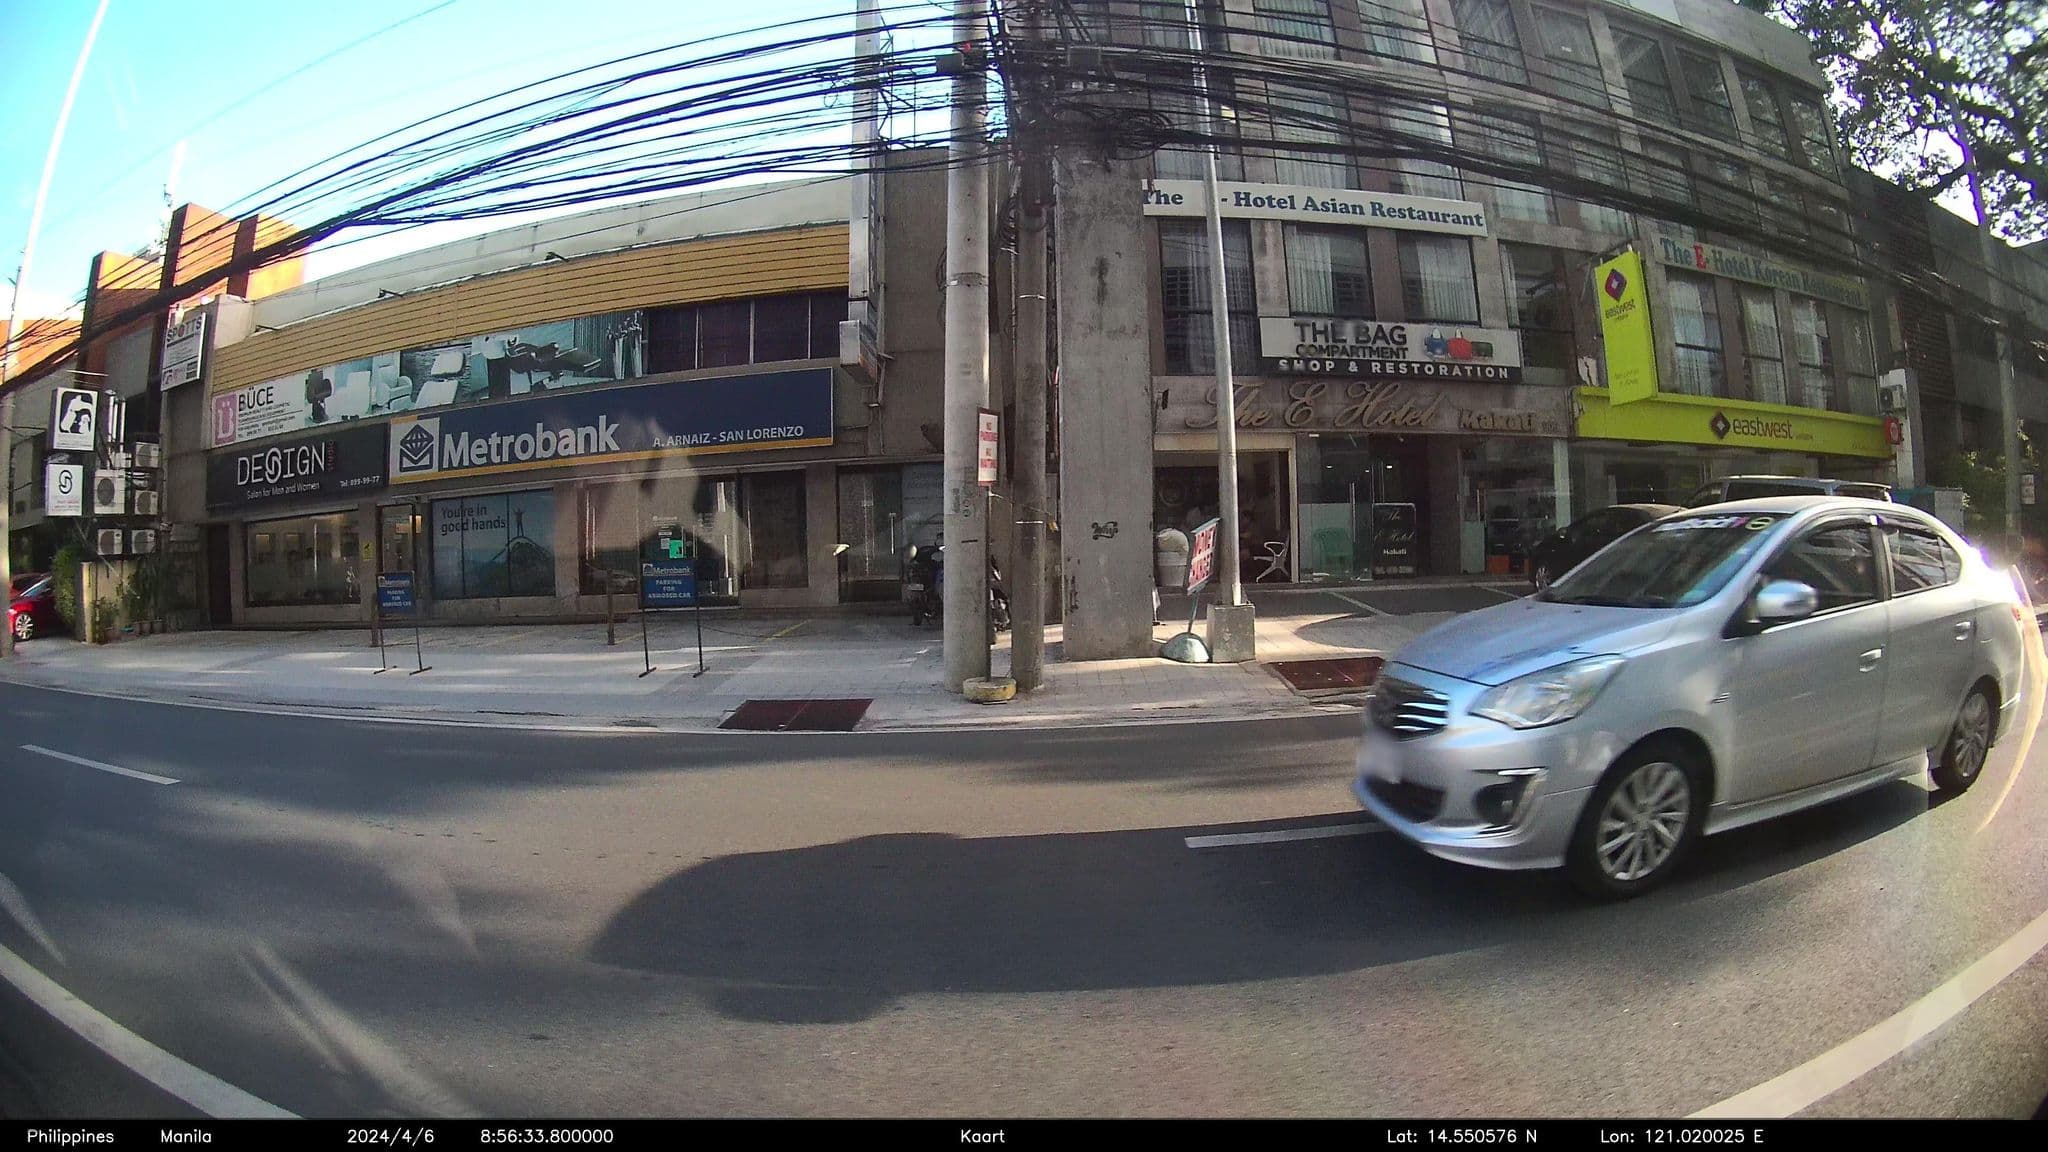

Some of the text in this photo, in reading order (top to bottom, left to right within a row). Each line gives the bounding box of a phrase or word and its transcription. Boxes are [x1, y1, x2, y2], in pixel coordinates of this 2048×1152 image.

[1143, 189, 1183, 206] The
[1233, 191, 1297, 210] Hotel
[1303, 198, 1366, 216] Asian
[1370, 201, 1484, 228] Restaurant
[1660, 237, 1693, 266] The
[1712, 250, 1750, 278] Hotel
[1355, 323, 1407, 346] BAG
[1295, 343, 1409, 360] COMPARTMENT
[1279, 359, 1508, 379] SHOP & RESTORATION
[238, 386, 274, 411] BÜCE
[1333, 381, 1444, 428] Hotel
[652, 437, 665, 448] A.
[666, 432, 711, 447] ARNAIZ
[719, 431, 744, 442] SAN
[746, 425, 804, 440] LORENZO
[1732, 416, 1793, 440] eastwest
[442, 415, 620, 469] Metrobank
[237, 442, 325, 484] DESIGN
[472, 515, 506, 531] hands
